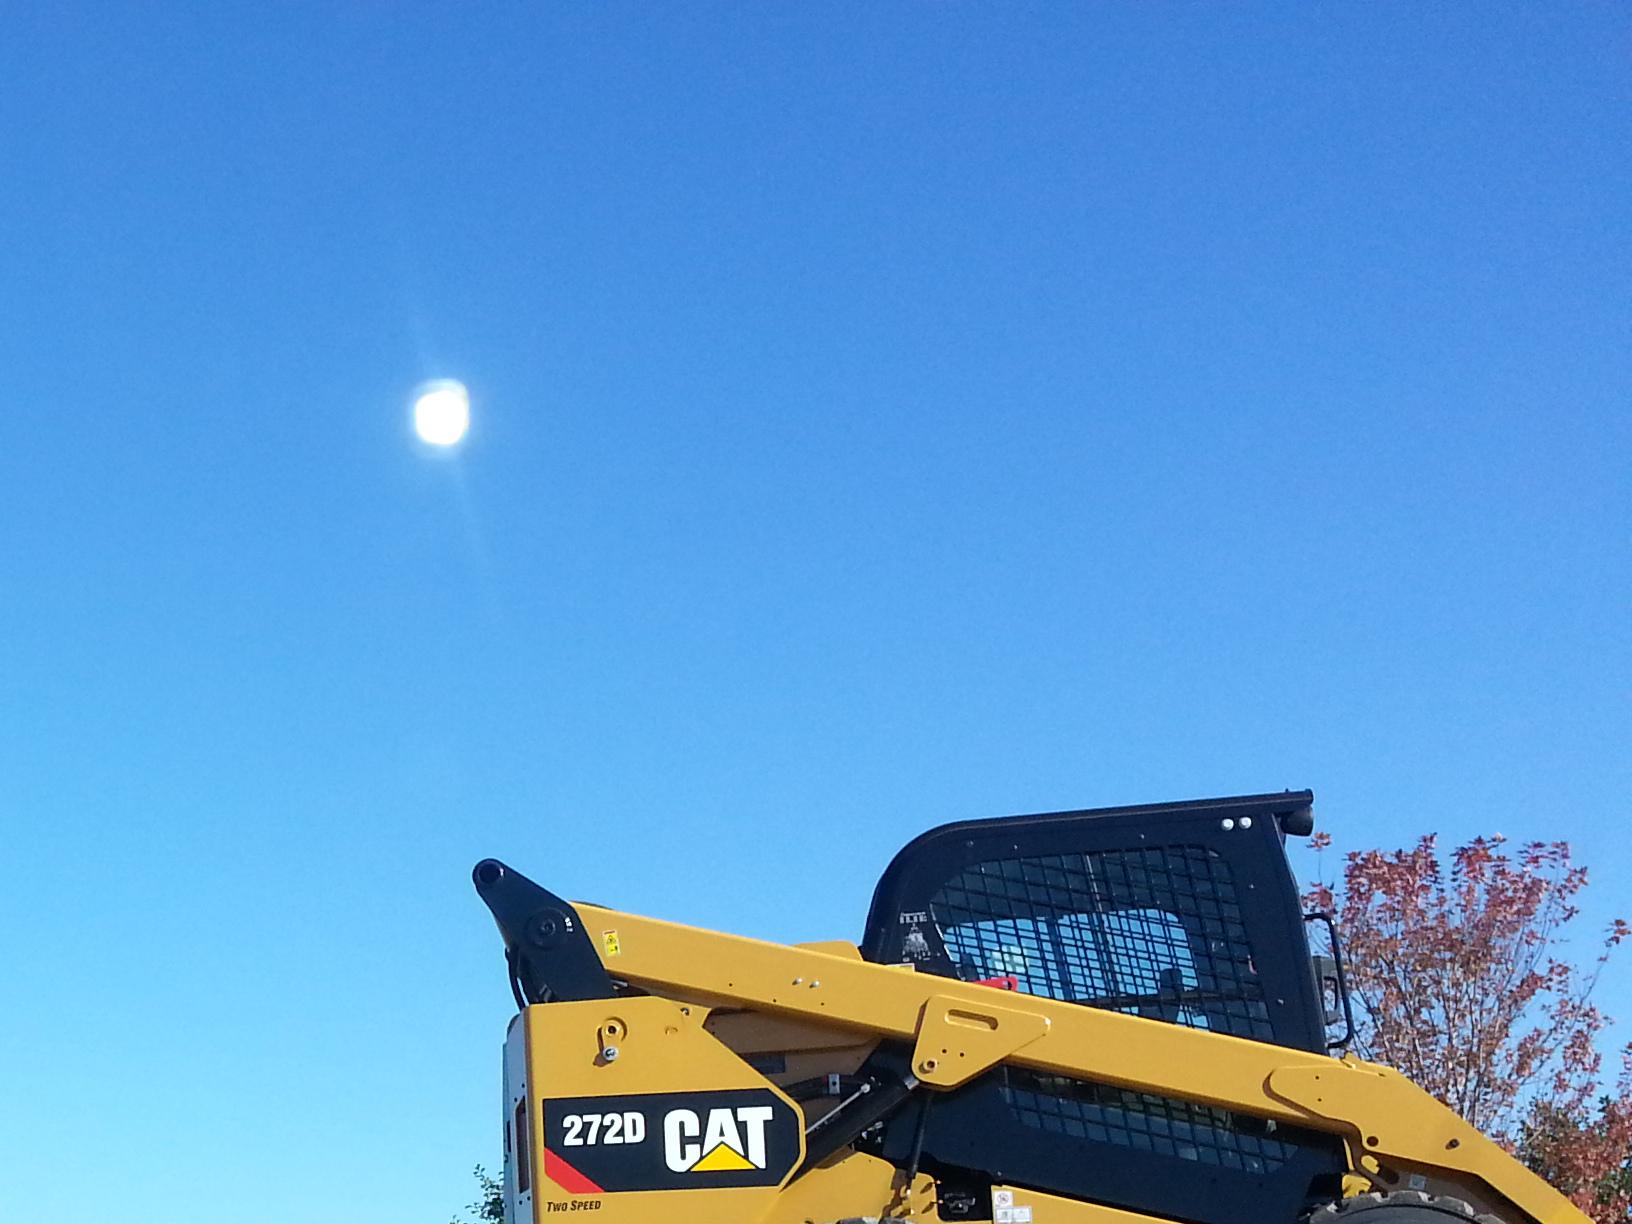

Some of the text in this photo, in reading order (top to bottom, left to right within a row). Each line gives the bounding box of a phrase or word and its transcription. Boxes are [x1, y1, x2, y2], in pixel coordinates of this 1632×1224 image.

[562, 1106, 773, 1172] 272D CAT
[547, 1200, 601, 1212] TWO SPEED
